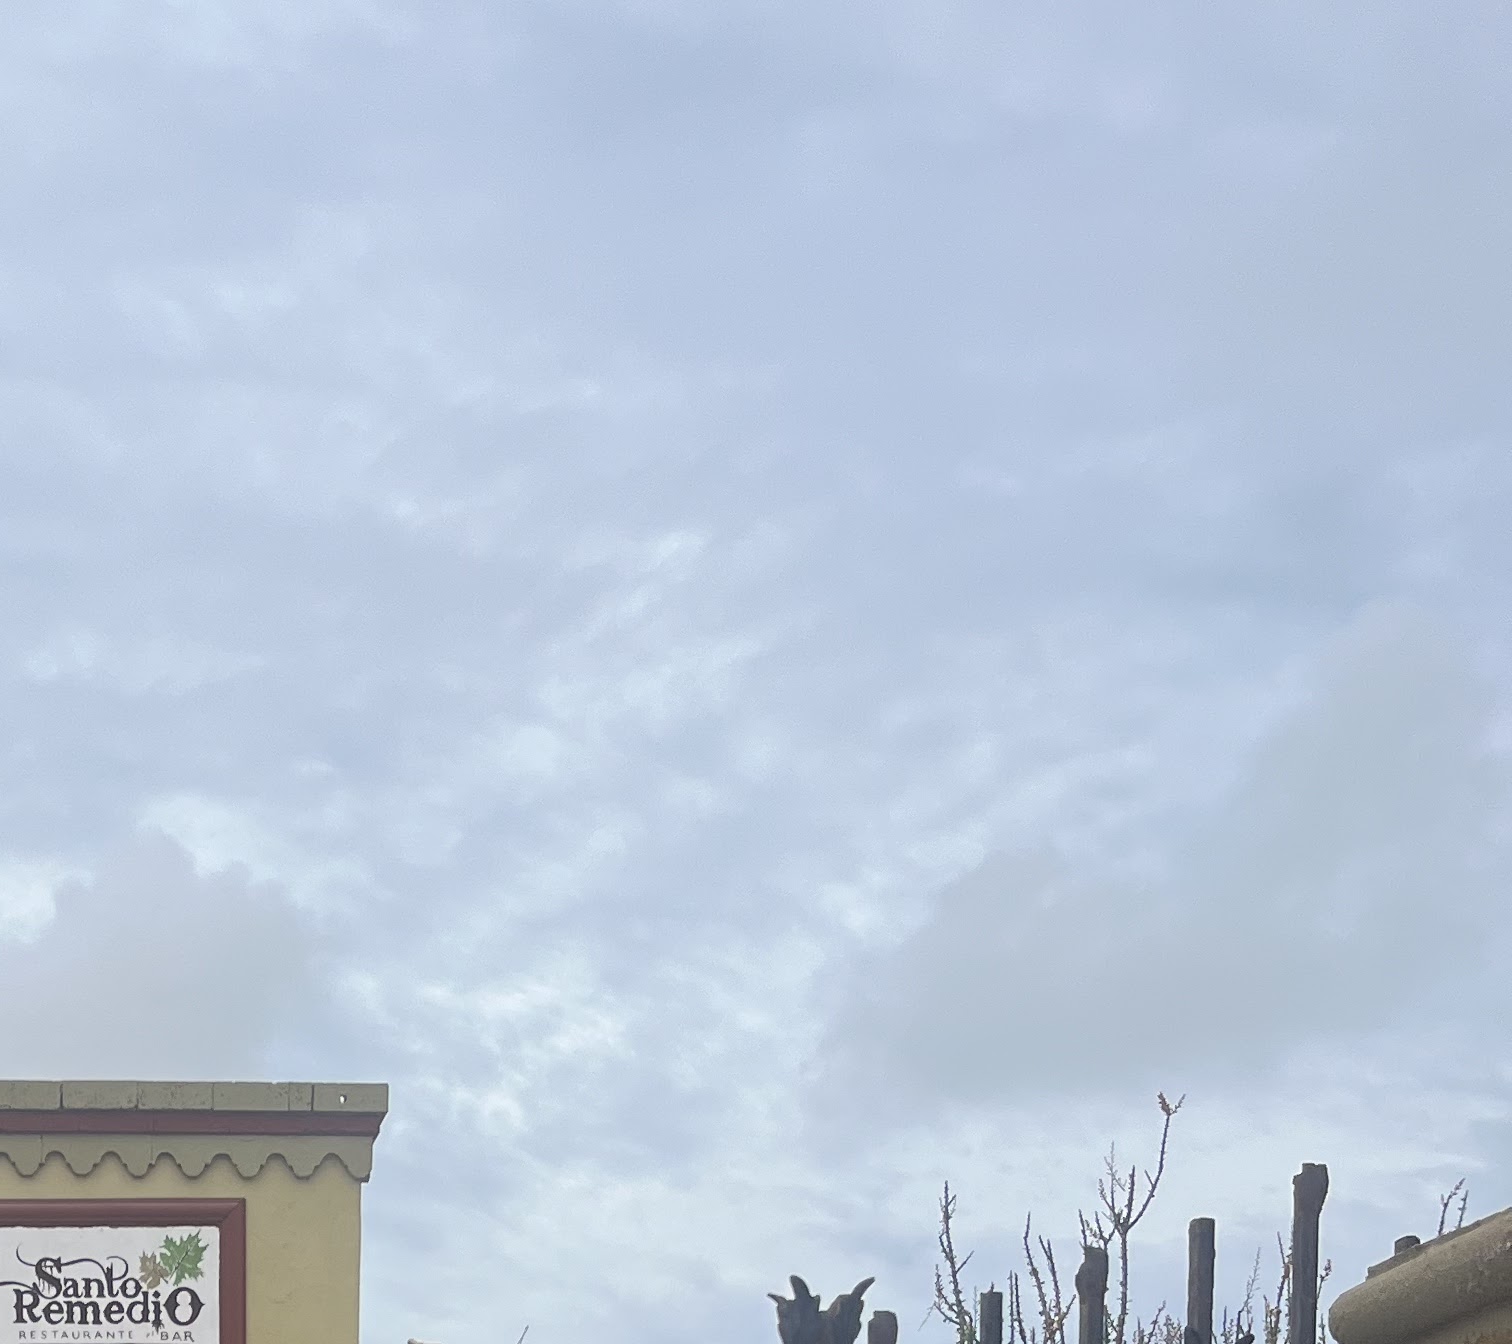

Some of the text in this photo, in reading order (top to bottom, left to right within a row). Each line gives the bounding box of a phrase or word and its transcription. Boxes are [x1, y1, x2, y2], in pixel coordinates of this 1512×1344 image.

[32, 1256, 143, 1300] Santo
[18, 1330, 195, 1342] RESTAURANTE BAR
